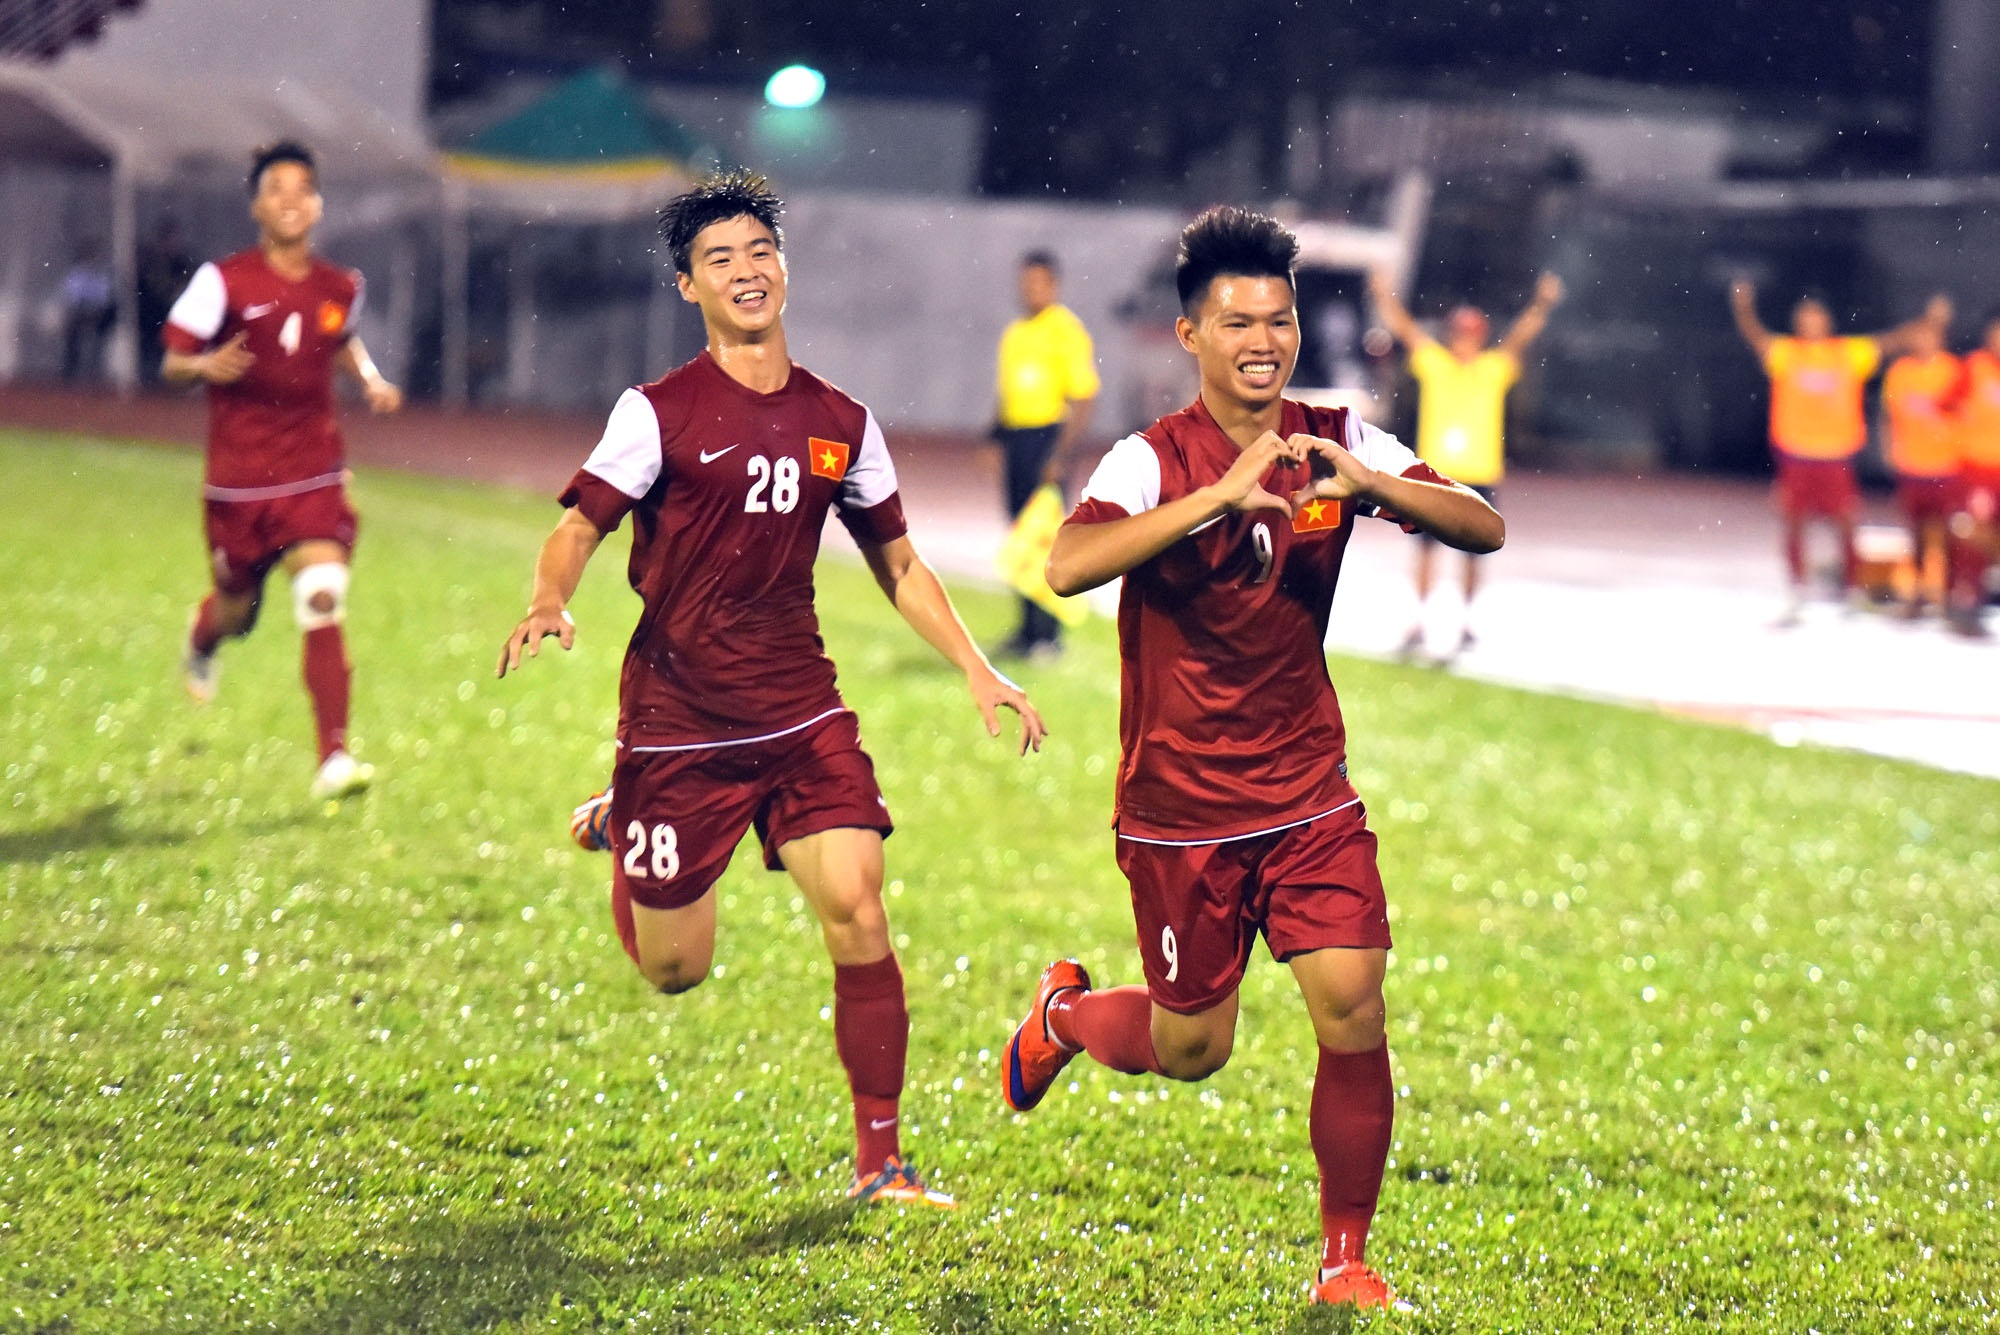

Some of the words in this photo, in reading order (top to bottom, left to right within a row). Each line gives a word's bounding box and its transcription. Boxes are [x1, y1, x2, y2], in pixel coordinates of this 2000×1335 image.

[278, 311, 303, 357] 4
[744, 454, 800, 515] 28
[1252, 522, 1272, 584] 9
[623, 819, 680, 881] 28
[1162, 925, 1178, 983] 9
